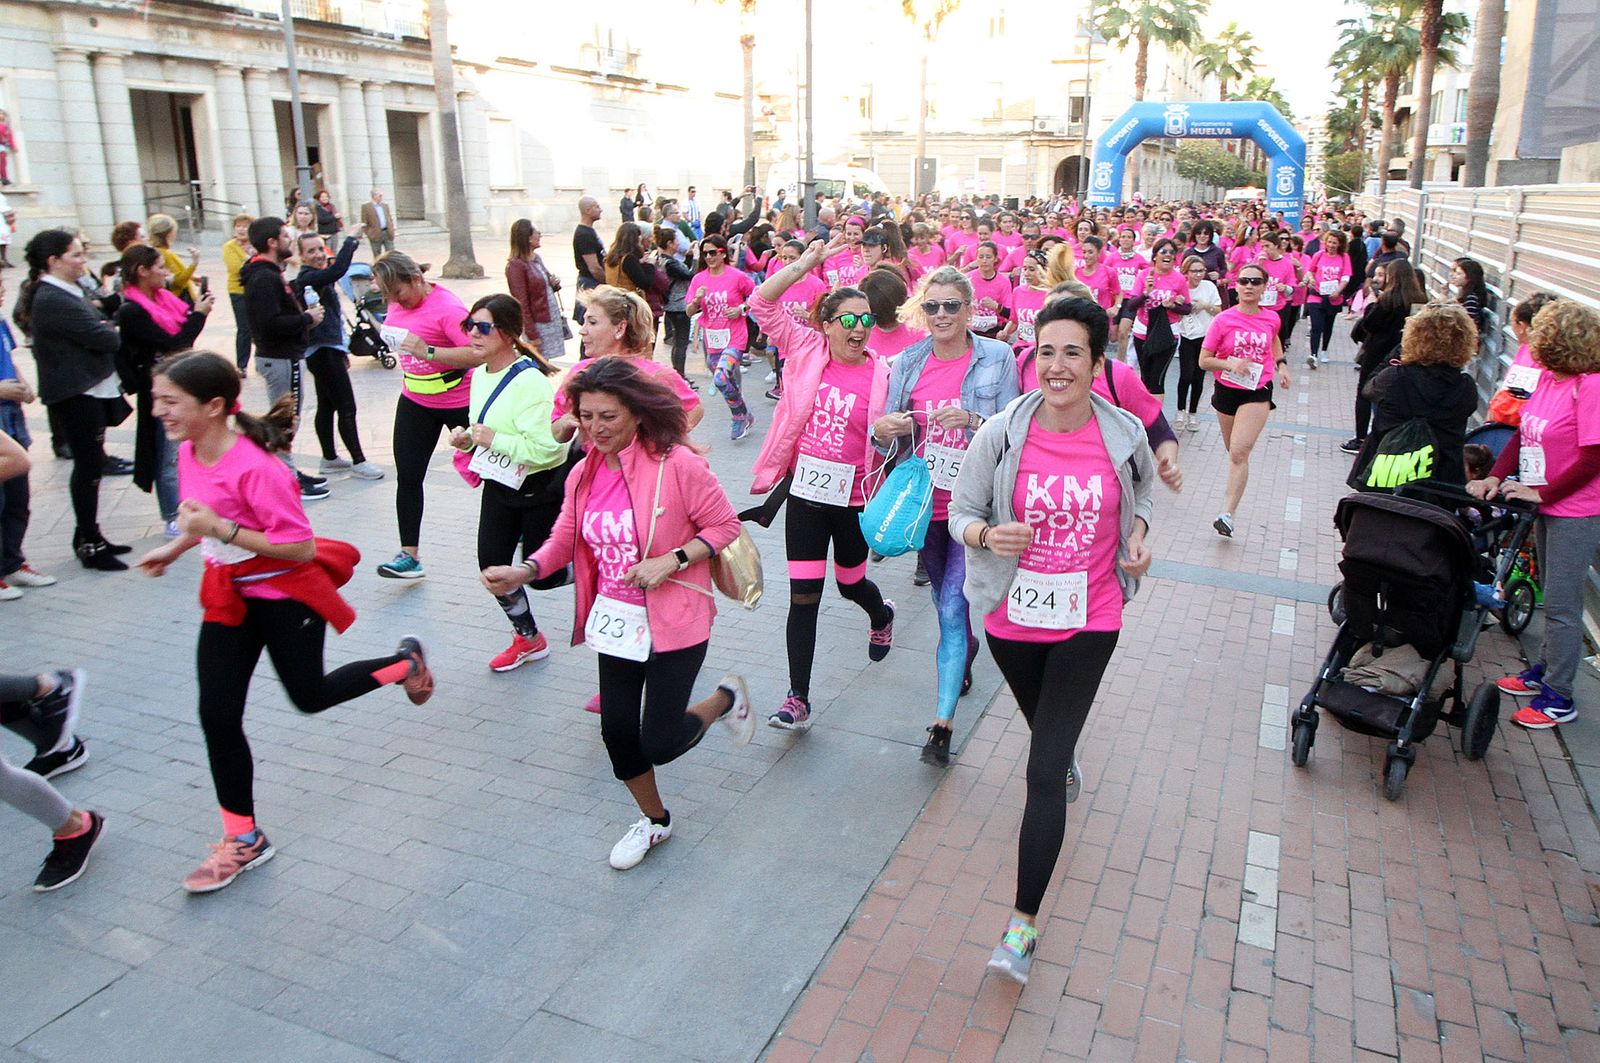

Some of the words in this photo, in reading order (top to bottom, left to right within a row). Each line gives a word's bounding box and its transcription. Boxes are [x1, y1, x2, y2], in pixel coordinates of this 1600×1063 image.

[1106, 117, 1139, 148] DEPORTES
[1257, 119, 1290, 151] DEPORTES
[704, 290, 728, 305] KM
[1234, 331, 1267, 348] KM
[813, 410, 849, 434] OR
[805, 423, 845, 447] LLAS
[926, 453, 961, 478] 815
[1366, 444, 1434, 488] NIKE
[801, 467, 832, 490] 122
[1025, 474, 1103, 511] KM
[582, 509, 634, 544] KM
[1024, 509, 1100, 534] POR
[1030, 528, 1095, 551] LLAS
[1019, 574, 1044, 585] Carrera
[1011, 585, 1056, 610] 424
[591, 610, 626, 638] 123
